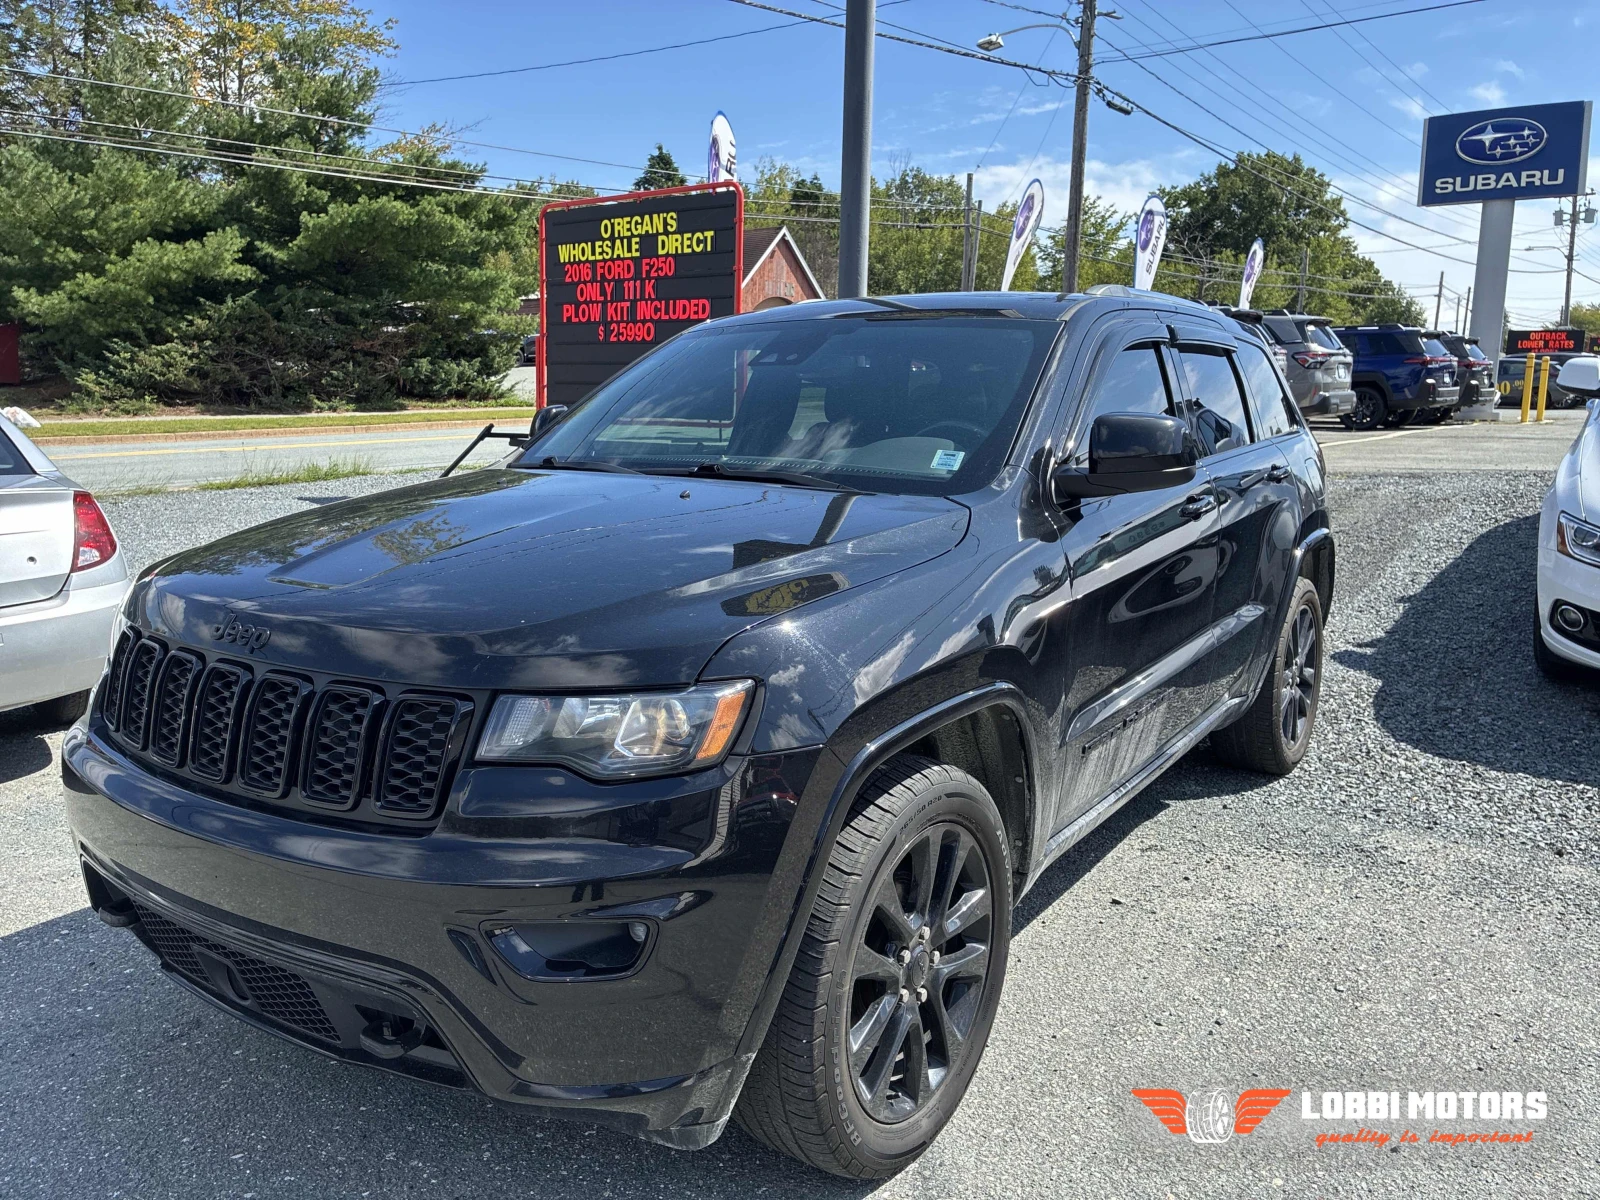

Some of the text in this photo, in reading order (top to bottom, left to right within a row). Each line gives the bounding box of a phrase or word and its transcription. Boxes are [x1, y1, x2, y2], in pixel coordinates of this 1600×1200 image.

[1435, 168, 1565, 194] SUBARU
[600, 212, 677, 238] O'REGAN'S
[558, 231, 714, 262] WHOLESALE DIRECT
[564, 256, 675, 283] 2016 FORD F250
[577, 282, 614, 301] ONLY
[563, 298, 710, 322] PLOW KIT INCLUDED
[609, 322, 655, 342] 25990
[1518, 340, 1574, 348] LOWER RATES
[1530, 332, 1567, 340] OUTBACK
[209, 613, 272, 655] Jeep
[899, 805, 926, 835] 265/50
